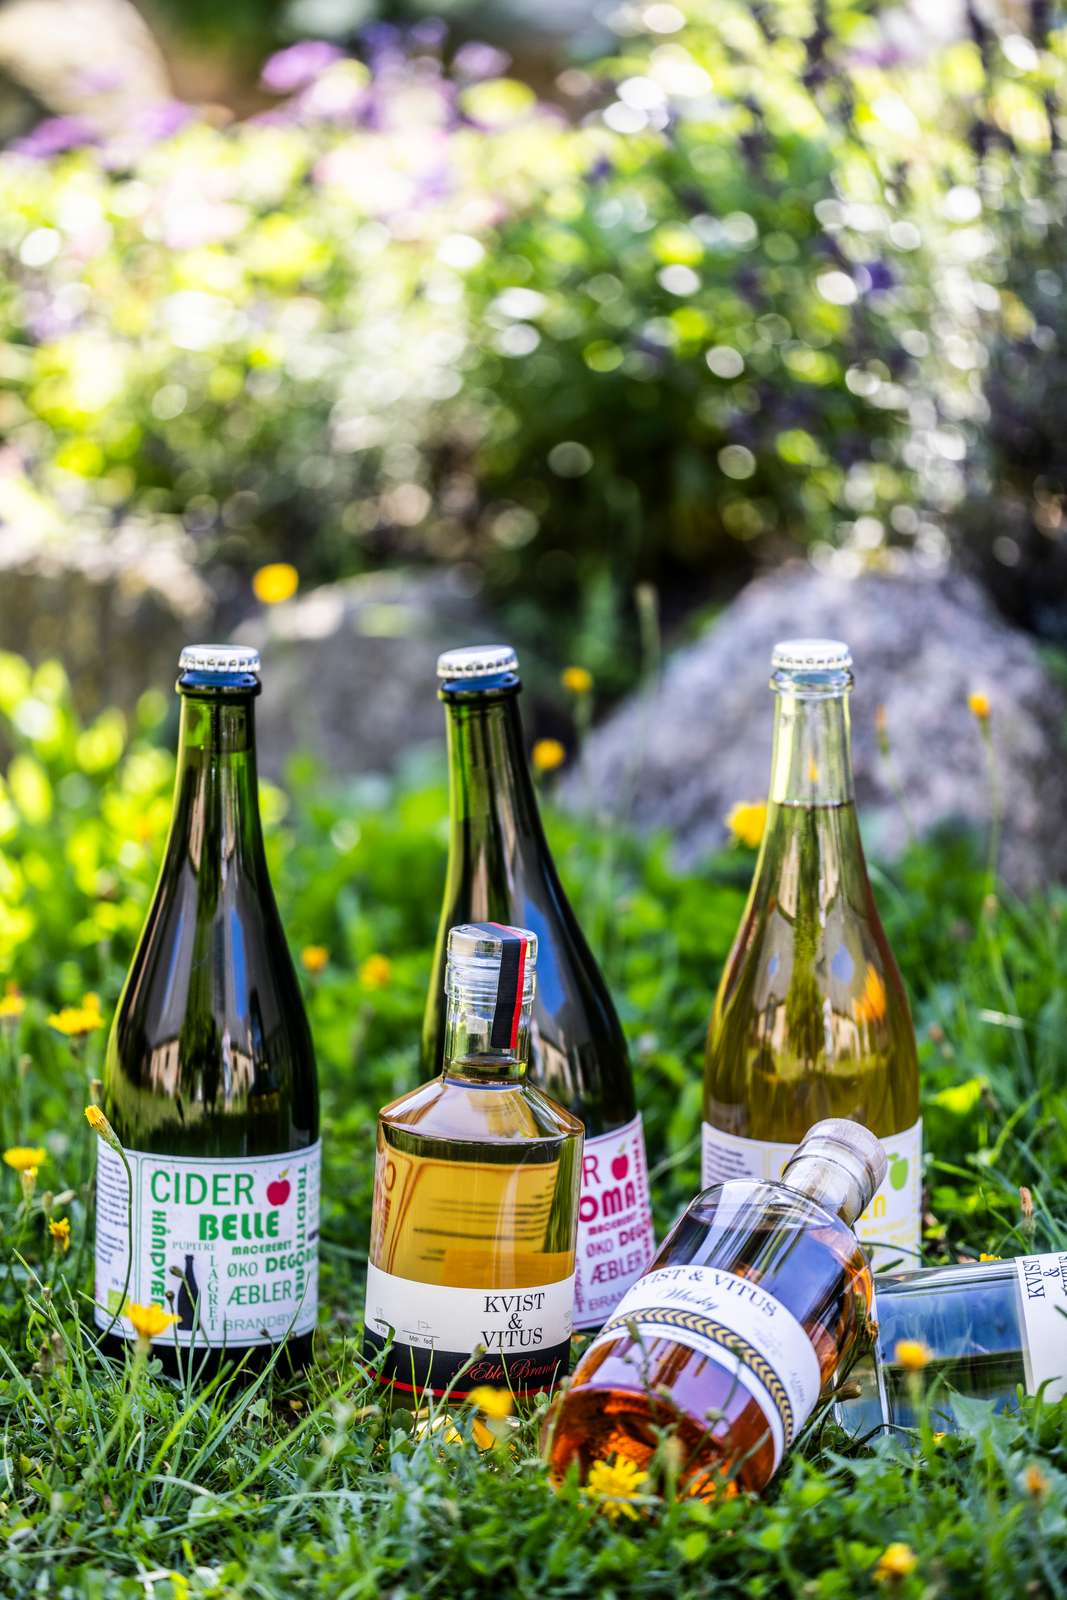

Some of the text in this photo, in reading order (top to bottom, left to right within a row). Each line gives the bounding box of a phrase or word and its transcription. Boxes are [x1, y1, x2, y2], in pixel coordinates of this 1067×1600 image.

[150, 1169, 255, 1206] CIDER
[579, 1179, 637, 1222] OMA
[199, 1210, 280, 1241] BELLE
[227, 1261, 259, 1278] ØKO
[1022, 1260, 1045, 1299] KVIST
[227, 1279, 292, 1306] ÆBLER
[483, 1292, 545, 1313] KVIST
[714, 1273, 777, 1317] VITUS
[508, 1312, 523, 1330] &
[481, 1327, 543, 1349] VITUS
